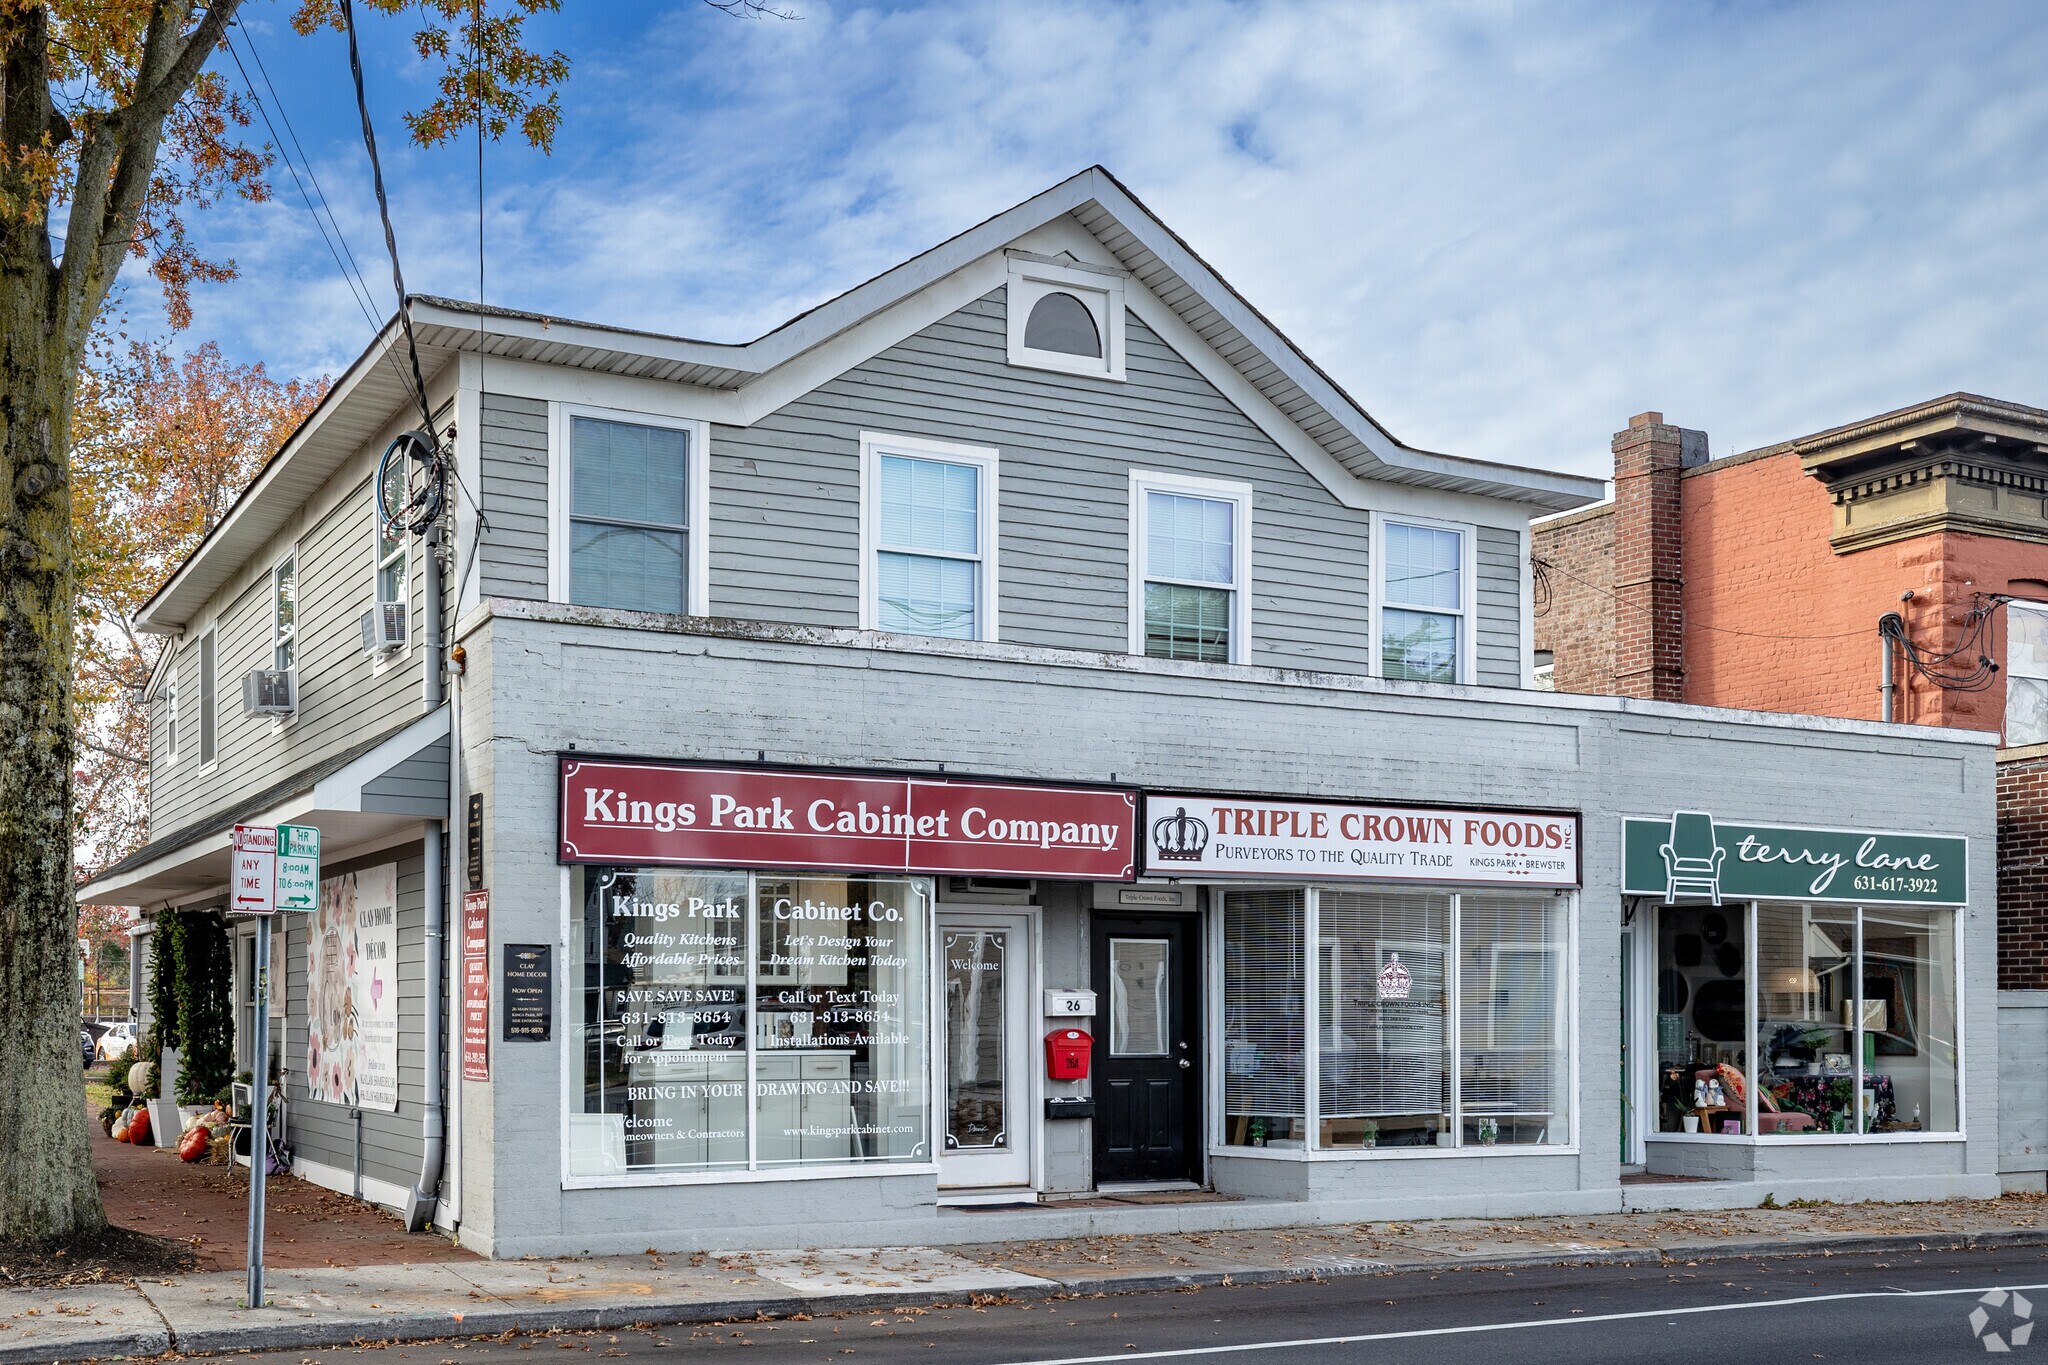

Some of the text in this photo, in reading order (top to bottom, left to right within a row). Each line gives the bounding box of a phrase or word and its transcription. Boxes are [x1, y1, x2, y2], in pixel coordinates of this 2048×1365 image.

[584, 788, 1119, 852] Kings Park Cabinet Company
[1212, 807, 1563, 849] TRIPLE CROWN FOODS
[243, 834, 275, 847] STANDING
[280, 832, 285, 853] 1
[297, 831, 309, 842] HR
[289, 843, 317, 856] PARKING
[1215, 843, 1453, 867] PURVEYORS TO THE QUALITY TRADE
[242, 859, 260, 870] ANY
[1469, 857, 1566, 870] KINGS PARK BREWSTER
[1735, 834, 1940, 895] terry lane
[241, 877, 260, 889] TIME
[1854, 875, 1938, 893] 631-617-3922
[612, 895, 904, 922] Kings Park Cabinet Co.
[360, 906, 393, 928] CLAY HOME
[624, 932, 738, 948] Quality Kitchens
[784, 934, 894, 949] Let's Design Your
[968, 940, 981, 952] 26
[621, 953, 740, 968] Affordable Prices
[769, 953, 908, 969] Dream Kitchen Today
[951, 958, 999, 970] Welcome
[617, 989, 735, 1002] SAVE SAVE SAVE!
[778, 990, 900, 1007] Call or Text Today
[1066, 1000, 1081, 1012] 26
[621, 1011, 732, 1025] 631-813-8654
[789, 1010, 889, 1024] 631-813-8654
[616, 1034, 642, 1047] Call
[645, 1037, 660, 1046] or
[697, 1034, 736, 1048] Today
[770, 1033, 910, 1047] Installations Available
[624, 1052, 729, 1067] for Appointment
[627, 1079, 910, 1101] BRING IN YOUR DRAWING AND SAVE!!!
[612, 1114, 673, 1129] Welcome
[611, 1128, 745, 1141] Homeowners & Contractors
[783, 1124, 914, 1139] www.kingsparkcabinet.com
